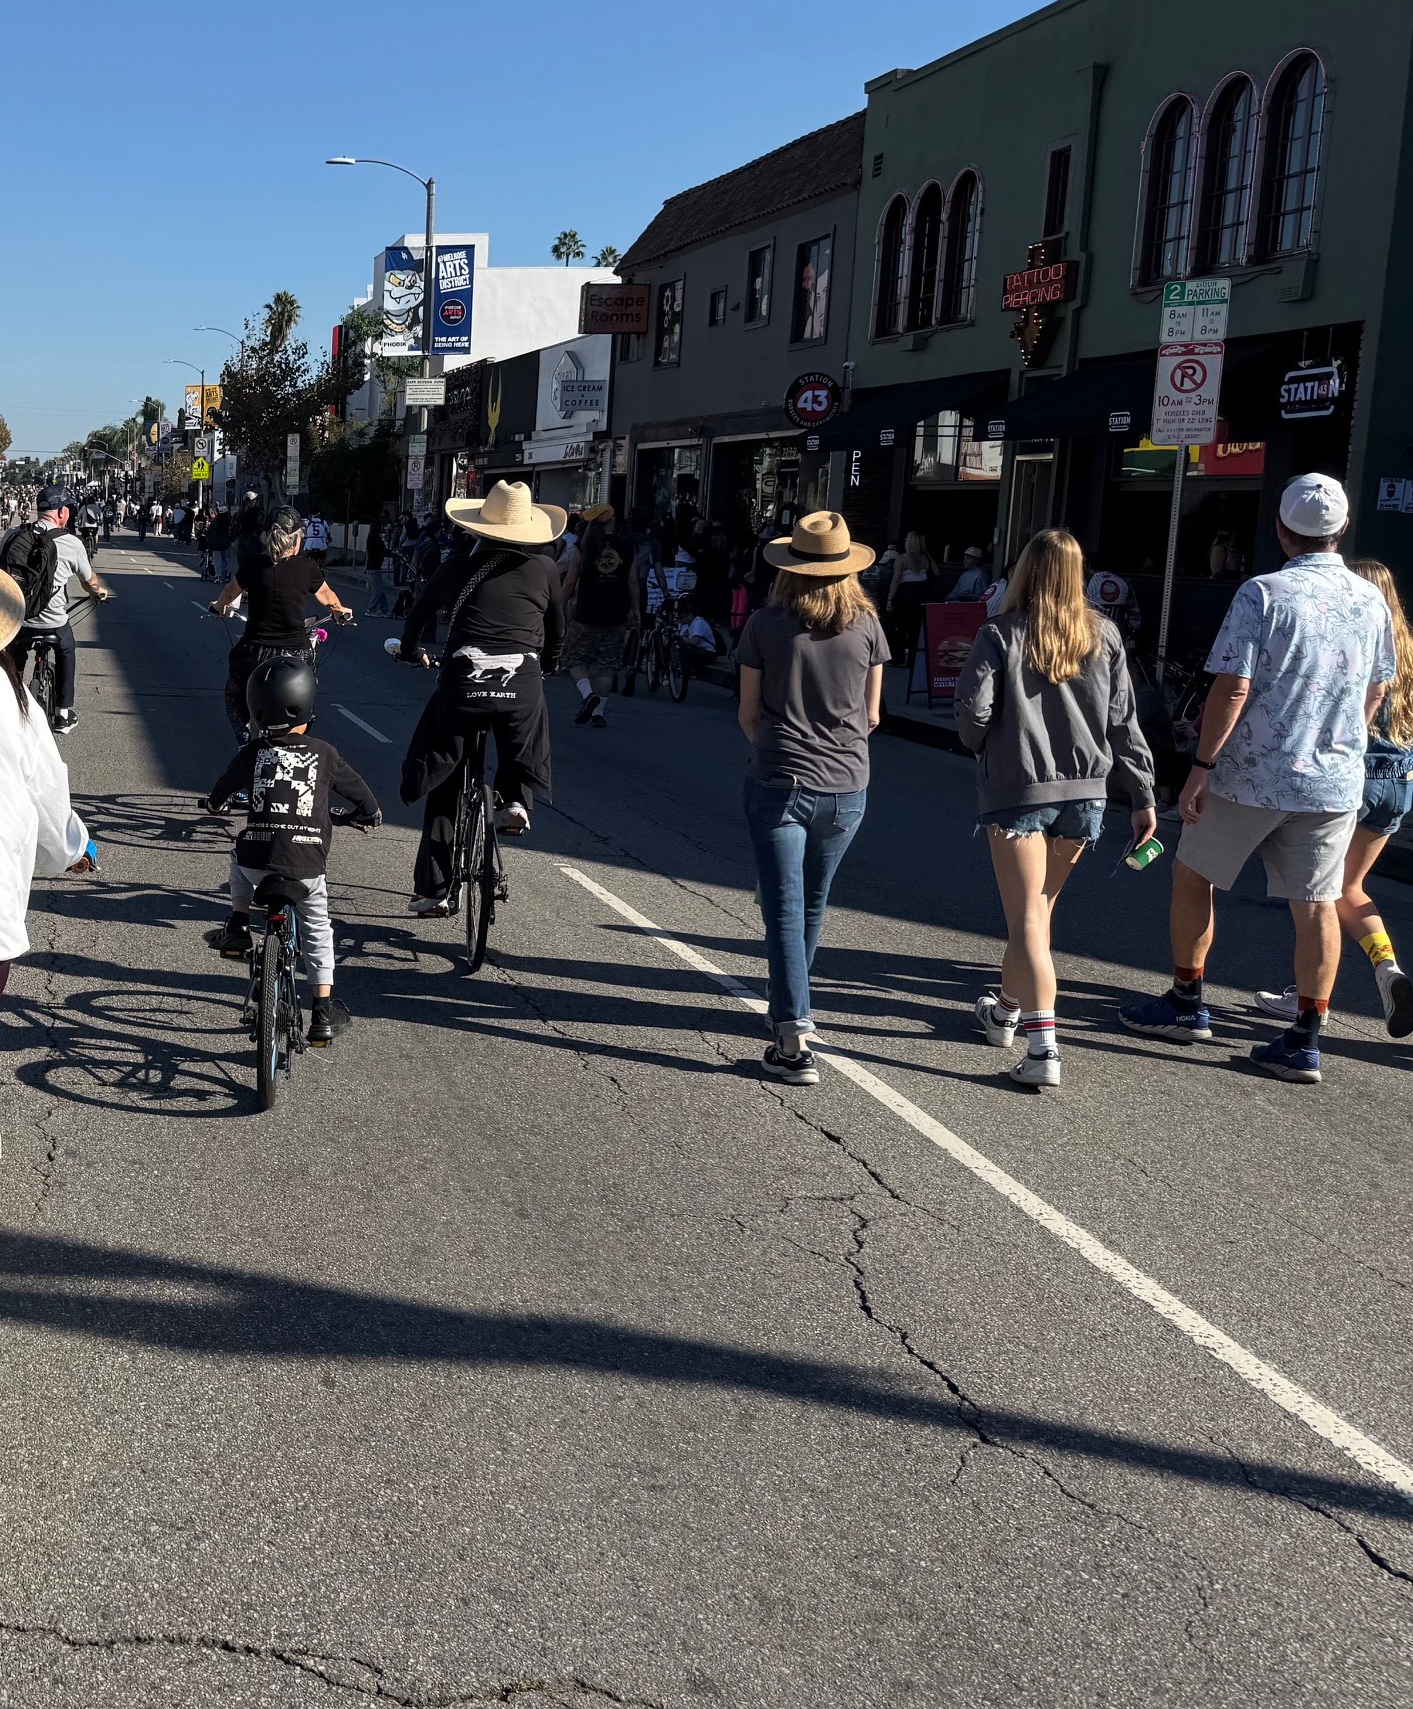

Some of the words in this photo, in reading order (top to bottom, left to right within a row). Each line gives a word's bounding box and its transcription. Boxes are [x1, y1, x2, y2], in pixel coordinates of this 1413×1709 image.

[439, 259, 469, 279] ARTS
[1005, 263, 1063, 289] TATTOO
[439, 274, 470, 290] DISTRICT
[1002, 284, 1061, 309] PIERCING
[1169, 284, 1181, 300] 2
[1187, 287, 1227, 300] PARKING
[589, 294, 645, 309] Escape
[590, 310, 642, 323] Rooms
[578, 384, 603, 392] CREAM
[799, 374, 834, 388] STATION
[797, 389, 828, 412] 43
[1108, 416, 1131, 426] STATION
[850, 450, 862, 487] PEN
[313, 524, 319, 536] 5
[489, 691, 517, 699] EARTH
[1176, 1014, 1196, 1022] HOKA
